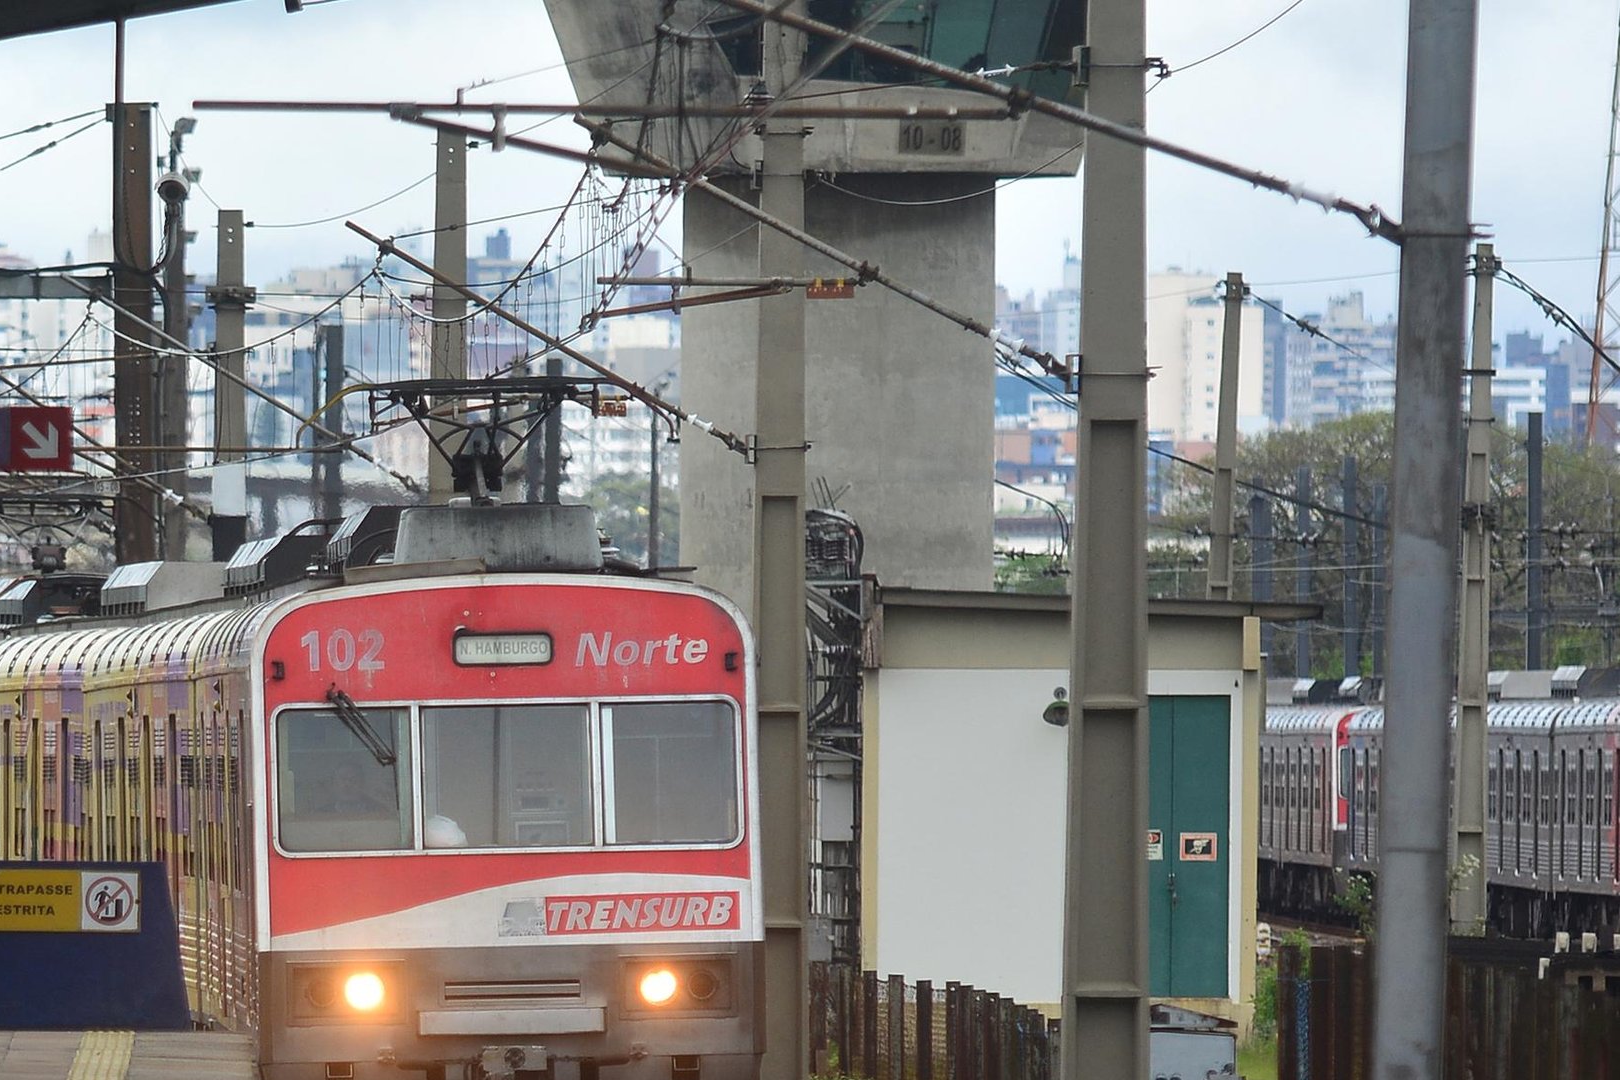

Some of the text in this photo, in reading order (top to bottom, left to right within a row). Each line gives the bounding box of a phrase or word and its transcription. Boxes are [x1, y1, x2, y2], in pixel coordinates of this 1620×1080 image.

[301, 628, 385, 672] 102
[460, 641, 548, 655] N. HAMBURGO
[575, 631, 709, 667] Norte
[548, 896, 734, 932] TRENSURB
